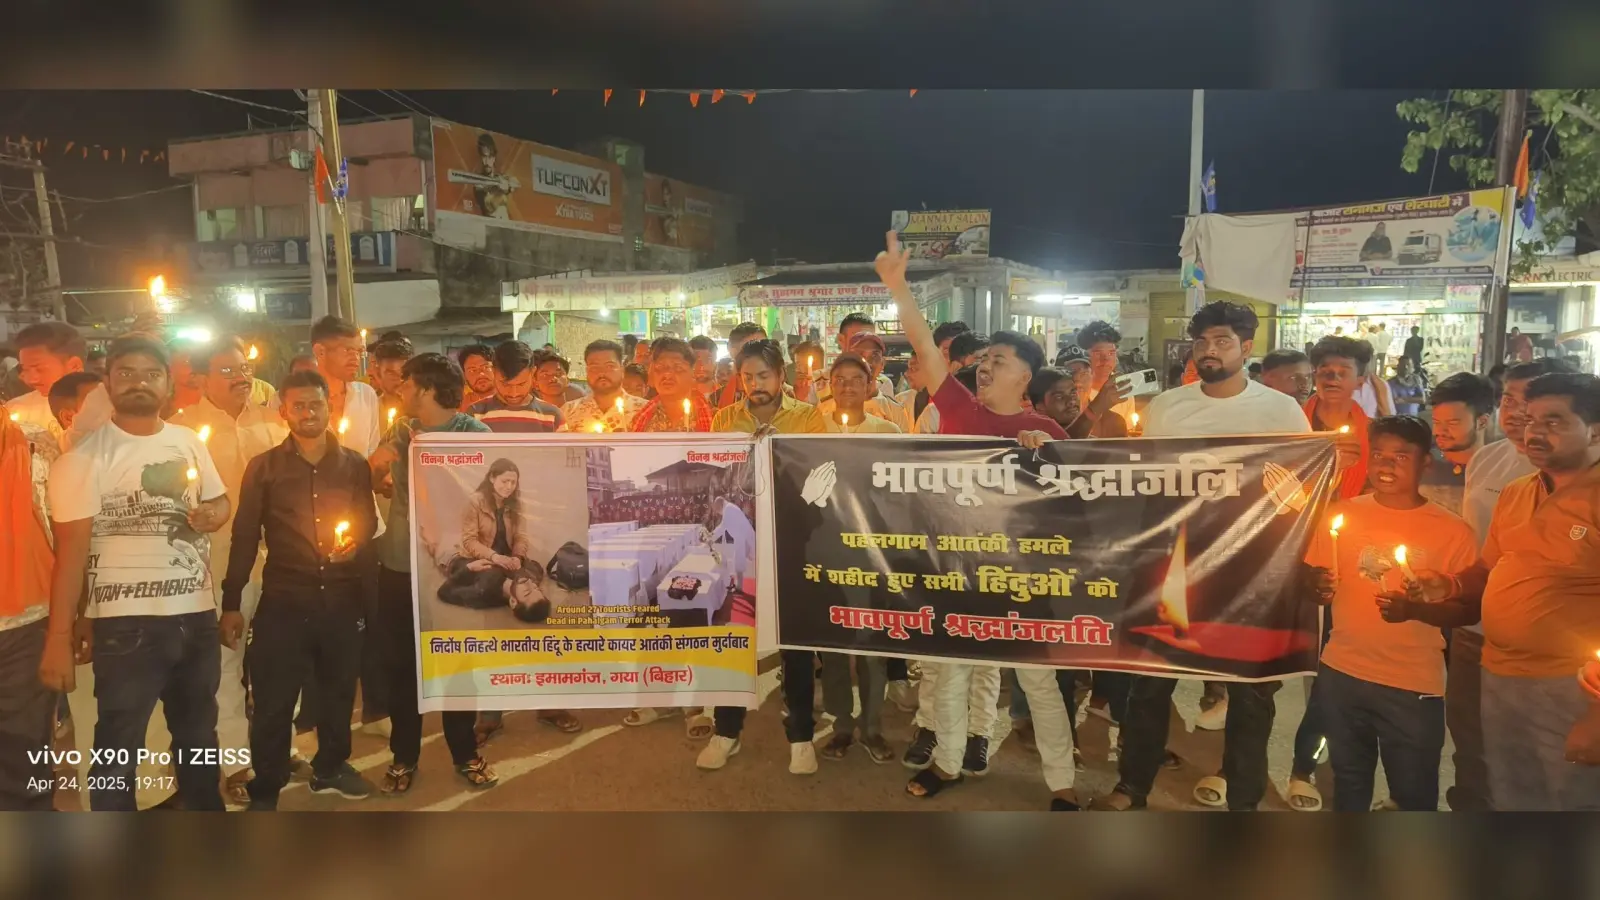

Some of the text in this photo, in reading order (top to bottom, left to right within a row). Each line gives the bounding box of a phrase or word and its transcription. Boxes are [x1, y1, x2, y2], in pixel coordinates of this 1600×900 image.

[957, 212, 989, 223] SALON
[872, 453, 1243, 506] भावपूर्ण श्रद्धांजलि
[840, 532, 1072, 555] पहलगाम आतंकी हमले
[803, 564, 1119, 602] में शहीद हुए सभी हिंदुओं को
[557, 605, 585, 614] Around
[599, 604, 631, 613] Tourists
[633, 604, 660, 613] Feared
[546, 616, 671, 626] Dead in Pahalgam Terror Attack
[829, 605, 1113, 645] भावपूर्ण श्रद्धांजलति
[430, 632, 749, 656] निर्दोष निहत्थे भारतीय हिंदू के हत्यारे कायर आतंकी संगठन मुर्दाबाद
[610, 671, 639, 684] गया
[643, 665, 693, 688] (बिहार)
